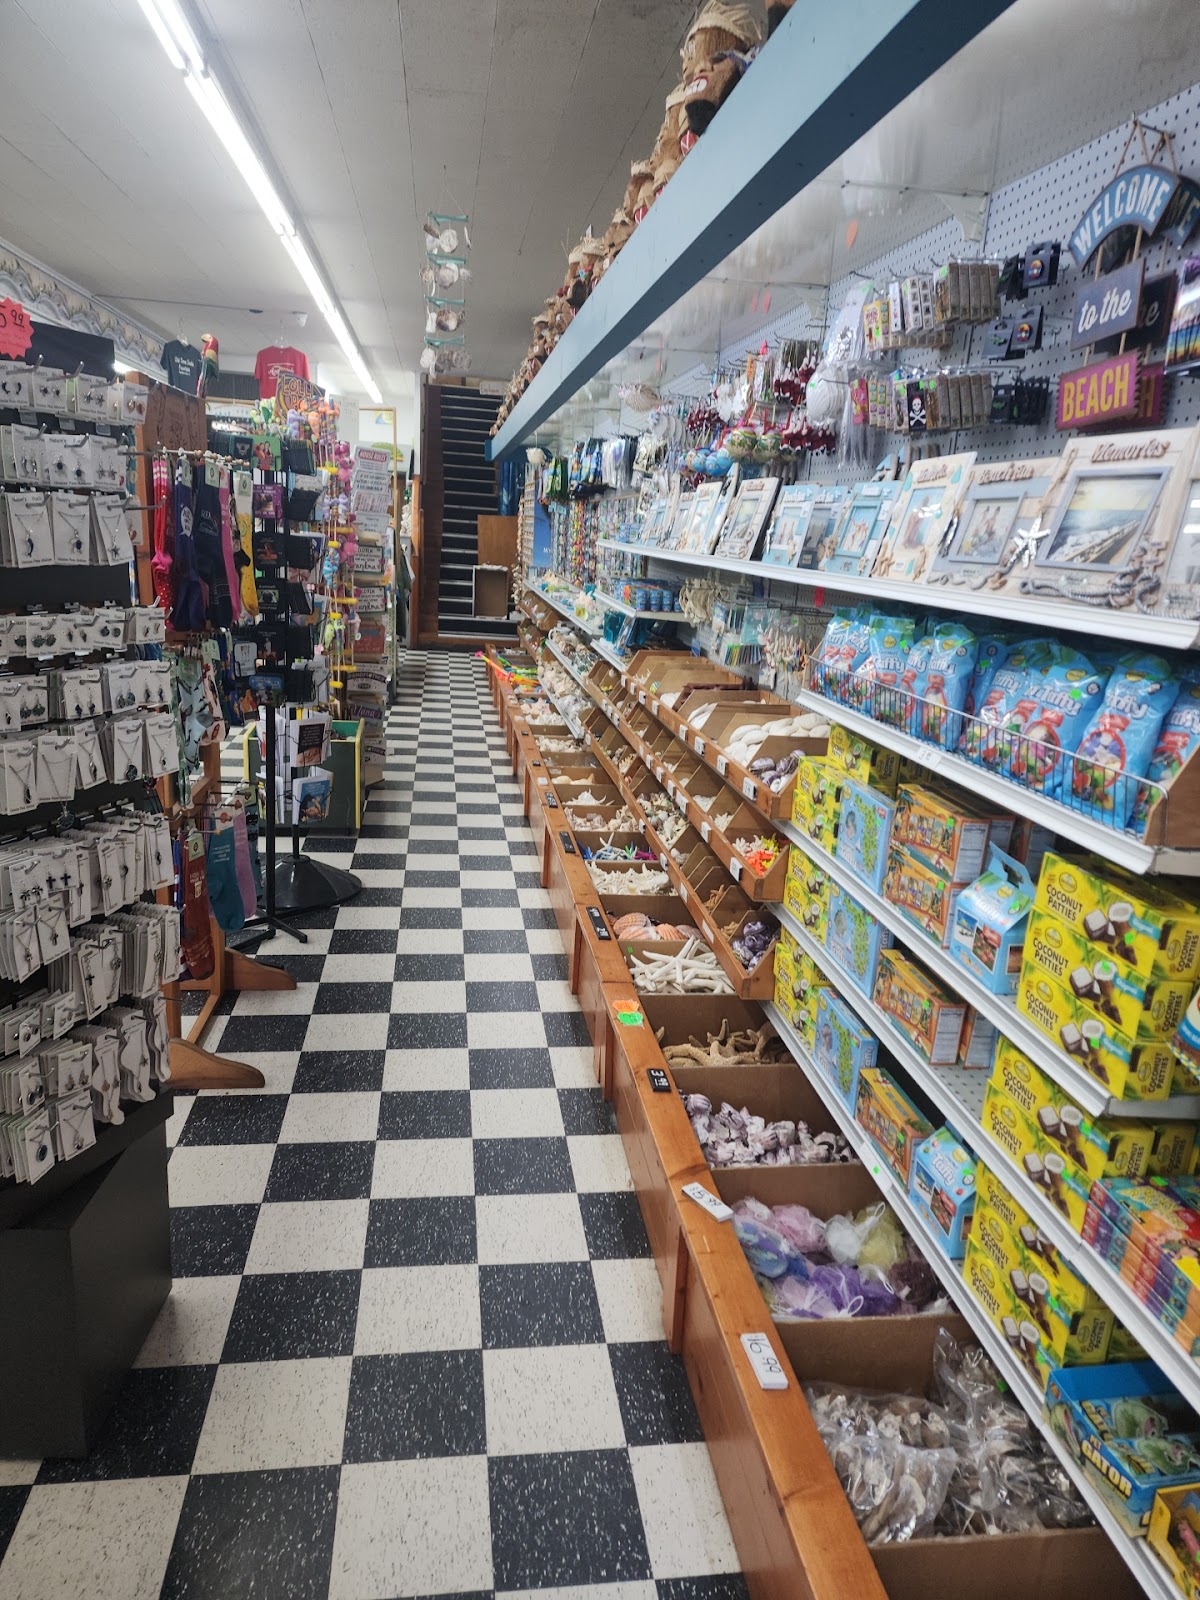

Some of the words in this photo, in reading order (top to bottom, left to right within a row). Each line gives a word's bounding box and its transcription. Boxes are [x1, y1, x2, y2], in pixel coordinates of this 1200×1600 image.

[1073, 173, 1171, 257] WELCOME
[1078, 300, 1098, 333] to
[1100, 287, 1132, 324] the
[1062, 362, 1130, 423] BEACH
[1041, 685, 1083, 717] Taffy
[1046, 883, 1083, 913] COCONUT
[1047, 898, 1077, 922] PATTIES
[1033, 937, 1069, 968] COCONUT
[1034, 950, 1063, 977] PATTIES
[1177, 930, 1193, 972] COCONUT
[1185, 935, 1199, 968] PATTIES
[1025, 990, 1059, 1022] COCONUT
[1027, 1003, 1054, 1031] PATTIES
[1162, 990, 1176, 1032] COCONUT
[1170, 995, 1183, 1027] PATTIES
[1002, 1067, 1037, 1104] COCONUT
[1149, 1052, 1163, 1093] COCONUT
[1156, 1057, 1169, 1089] PATTIES
[1004, 1079, 1031, 1111] PATTIES
[990, 1111, 1022, 1149] COCONUT
[992, 1123, 1017, 1156] PATTIES
[932, 1153, 956, 1187] Taffy
[987, 1184, 1017, 1221] COCONUT
[990, 1195, 1013, 1227] PATTIES
[979, 1221, 1009, 1265] COCONUT
[981, 1234, 1005, 1270] PATTIES
[971, 1266, 1001, 1311] COCONUT
[972, 1279, 996, 1317] PATTIES
[1089, 1434, 1103, 1450] PET
[1081, 1439, 1133, 1499] GATOR
